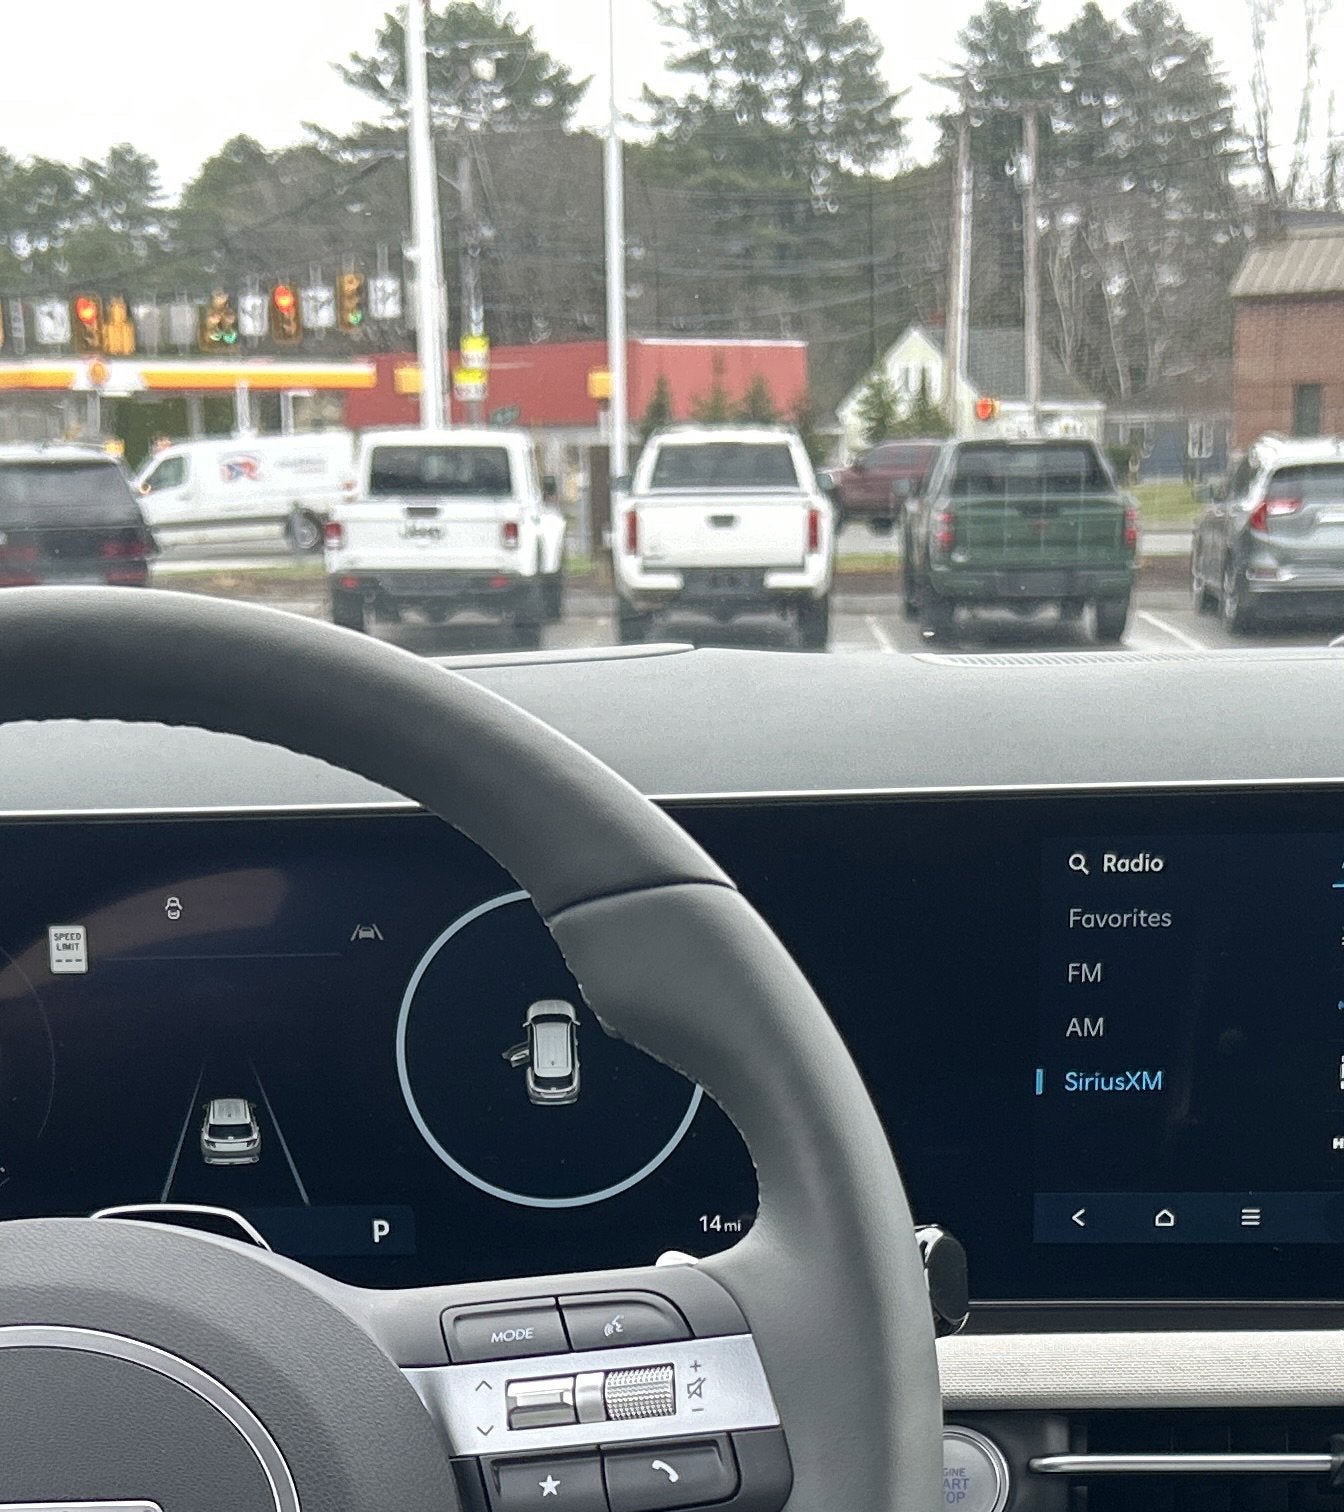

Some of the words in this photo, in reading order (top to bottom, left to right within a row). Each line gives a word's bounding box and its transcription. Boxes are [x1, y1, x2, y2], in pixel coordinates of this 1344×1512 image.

[1104, 853, 1163, 872] Radio
[1070, 909, 1171, 928] Favorites
[54, 932, 82, 941] SPEED
[1069, 963, 1101, 982] FM
[1066, 1017, 1103, 1036] AM
[1065, 1071, 1162, 1091] SiriusXM
[374, 1220, 389, 1242] P
[700, 1215, 721, 1231] 14
[725, 1220, 742, 1232] mi
[491, 1327, 534, 1342] MODE
[943, 1467, 966, 1477] GINE
[943, 1478, 969, 1490] ART
[943, 1491, 966, 1504] OP
